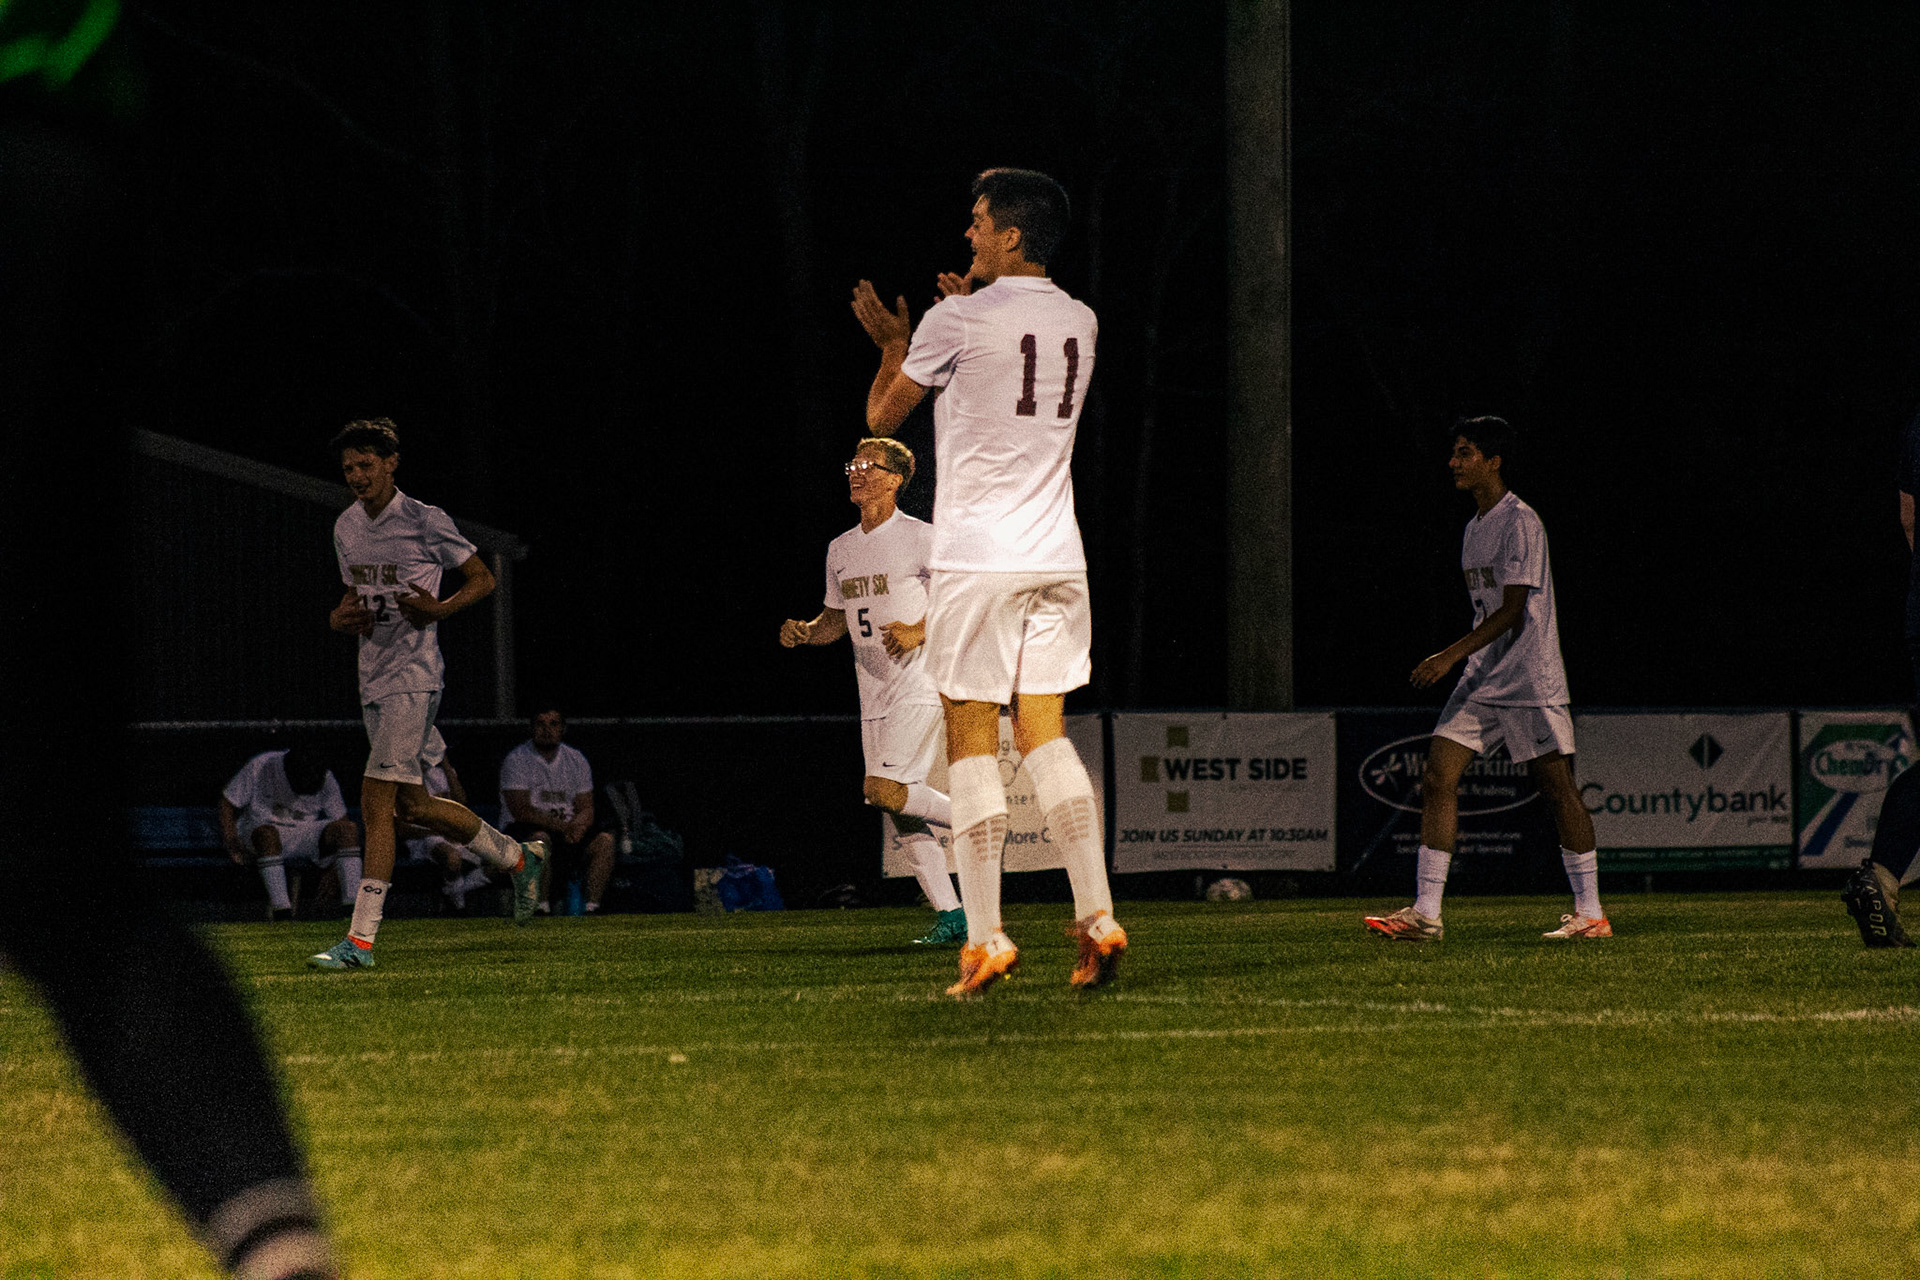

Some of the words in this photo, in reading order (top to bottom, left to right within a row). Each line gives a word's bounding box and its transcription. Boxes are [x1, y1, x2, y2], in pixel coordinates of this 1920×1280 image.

[1016, 333, 1079, 419] 11
[858, 607, 873, 637] 5
[1164, 758, 1241, 781] WEST
[1248, 758, 1308, 781] SIDE
[1579, 782, 1788, 822] Countybank
[1119, 829, 1155, 843] JOIN
[1159, 829, 1180, 842] US
[1183, 829, 1245, 843] SUNDAY
[1247, 828, 1267, 842] AT
